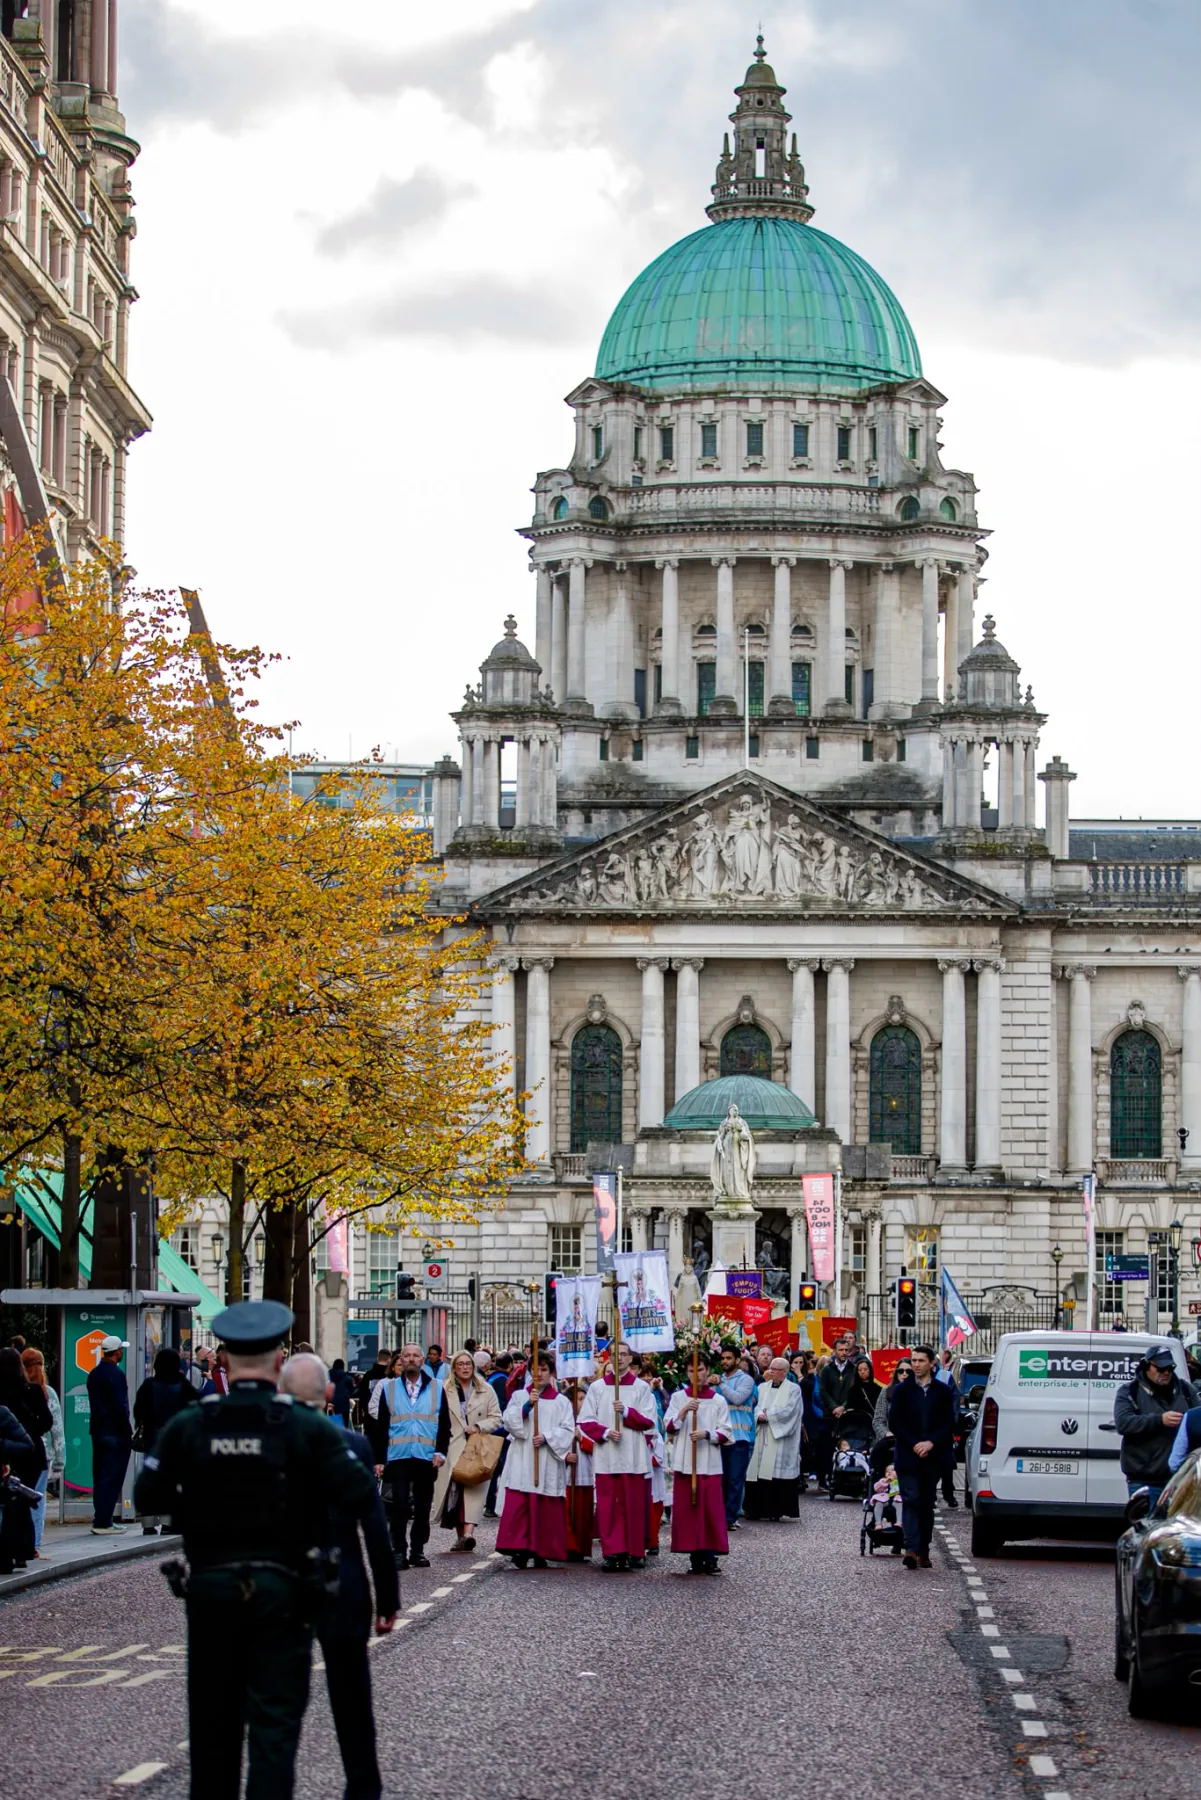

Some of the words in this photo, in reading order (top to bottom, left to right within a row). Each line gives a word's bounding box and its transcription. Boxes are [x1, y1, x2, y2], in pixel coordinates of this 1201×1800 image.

[431, 1267, 438, 1276] 2
[732, 1280, 758, 1289] TEMPUS
[1027, 1357, 1140, 1377] enterpris
[1018, 1380, 1079, 1388] enterprise.ie
[1091, 1381, 1116, 1389] 1800
[211, 1438, 262, 1455] POLICE
